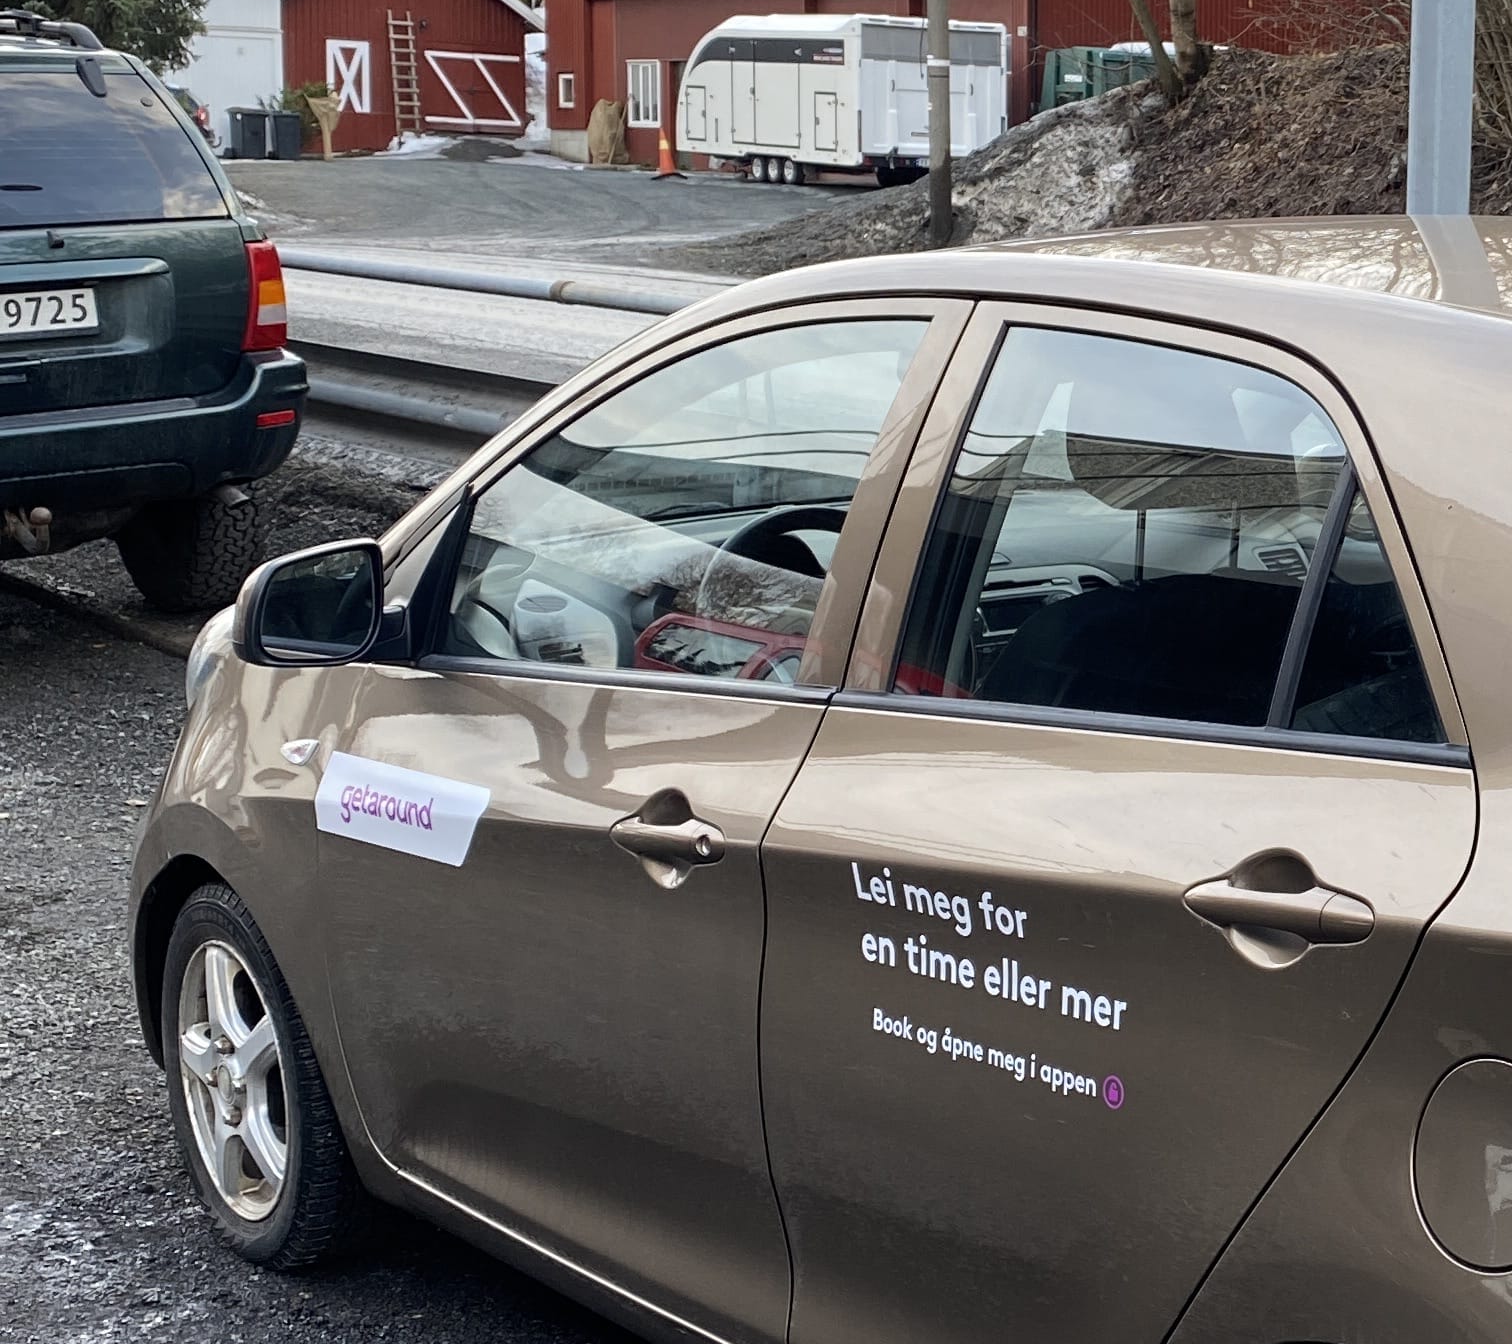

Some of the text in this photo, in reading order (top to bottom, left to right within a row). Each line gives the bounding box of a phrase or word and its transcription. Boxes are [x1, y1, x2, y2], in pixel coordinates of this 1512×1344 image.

[4, 293, 88, 329] 9725
[340, 784, 434, 831] getaround
[851, 861, 1028, 939] Lei meg for
[861, 932, 1128, 1031] en time eller mer
[872, 1007, 1097, 1097] Book og åpne meg i appen
